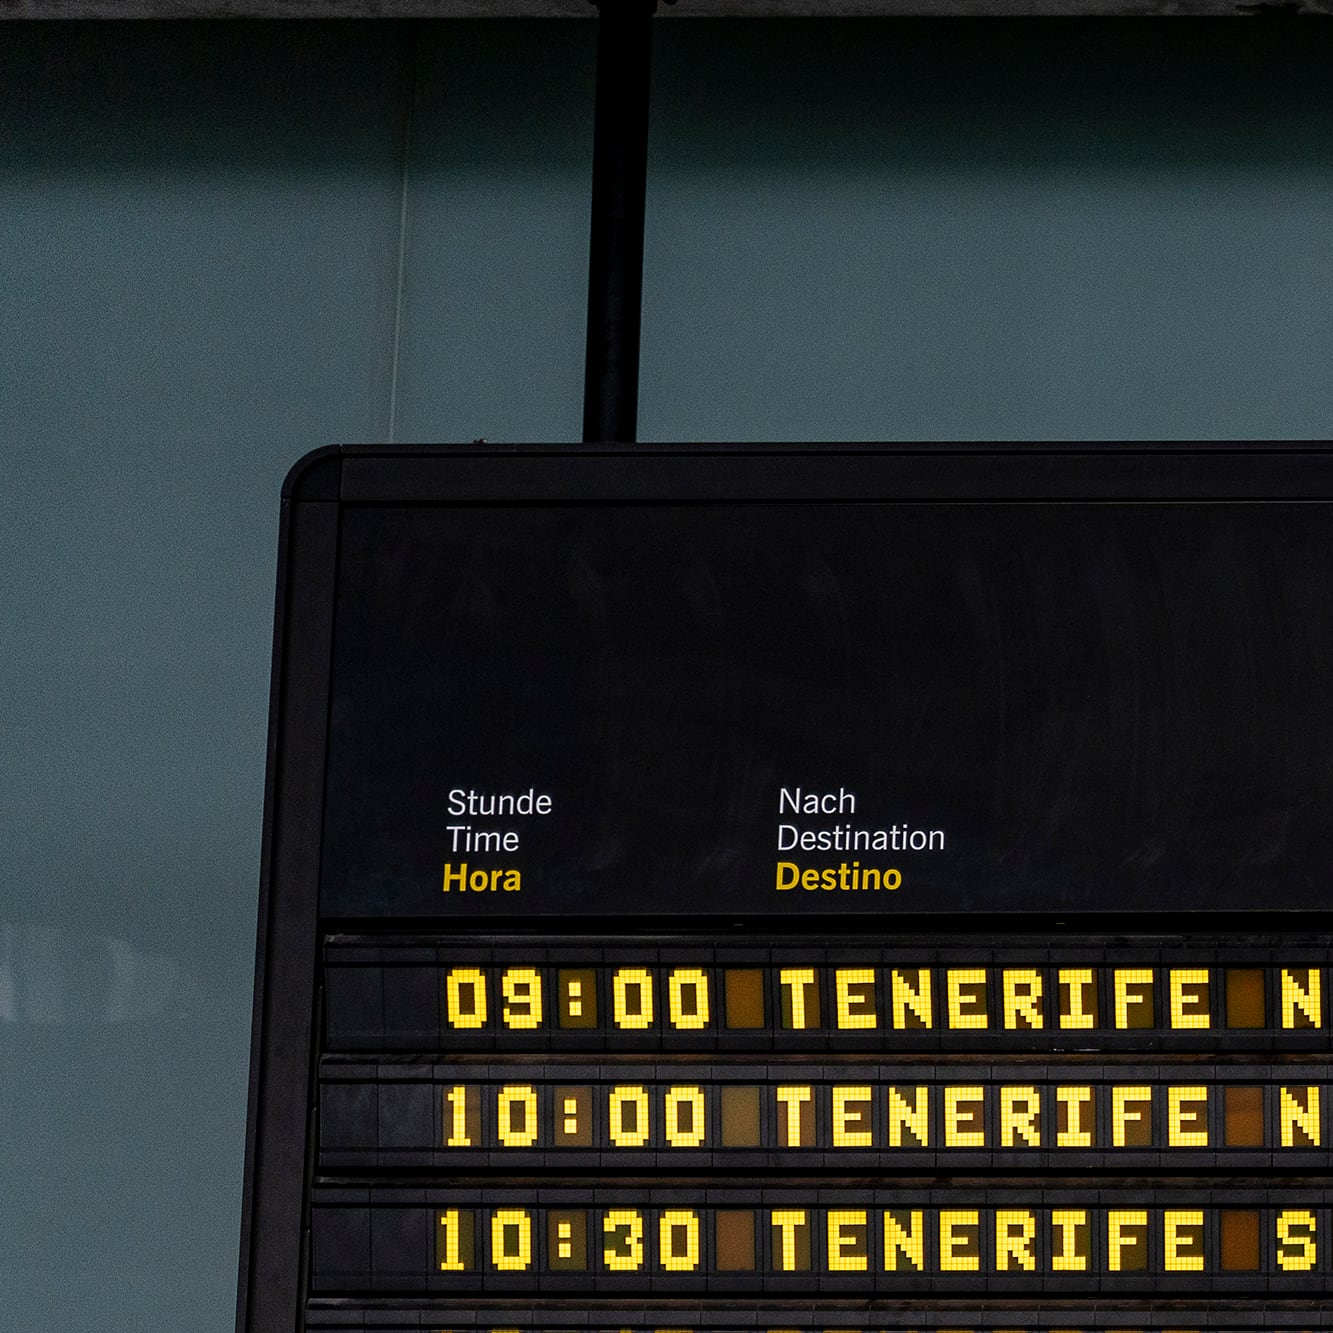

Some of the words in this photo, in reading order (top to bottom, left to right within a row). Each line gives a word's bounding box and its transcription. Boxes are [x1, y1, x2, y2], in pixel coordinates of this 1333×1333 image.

[448, 789, 551, 815] Stunde
[780, 788, 855, 813] Nach
[446, 826, 519, 852] Time
[778, 824, 944, 850] Destination
[443, 864, 520, 891] Hora
[776, 862, 901, 890] Destino
[446, 969, 710, 1030] 09:00
[780, 969, 1210, 1030] TENERIFE
[1281, 969, 1322, 1029] N
[447, 1086, 705, 1147] 10:00
[776, 1086, 1208, 1147] TENERIFE
[1280, 1086, 1321, 1147] N
[440, 1210, 700, 1271] 10:30
[771, 1210, 1204, 1271] TENERIFE
[1276, 1210, 1317, 1271] S
